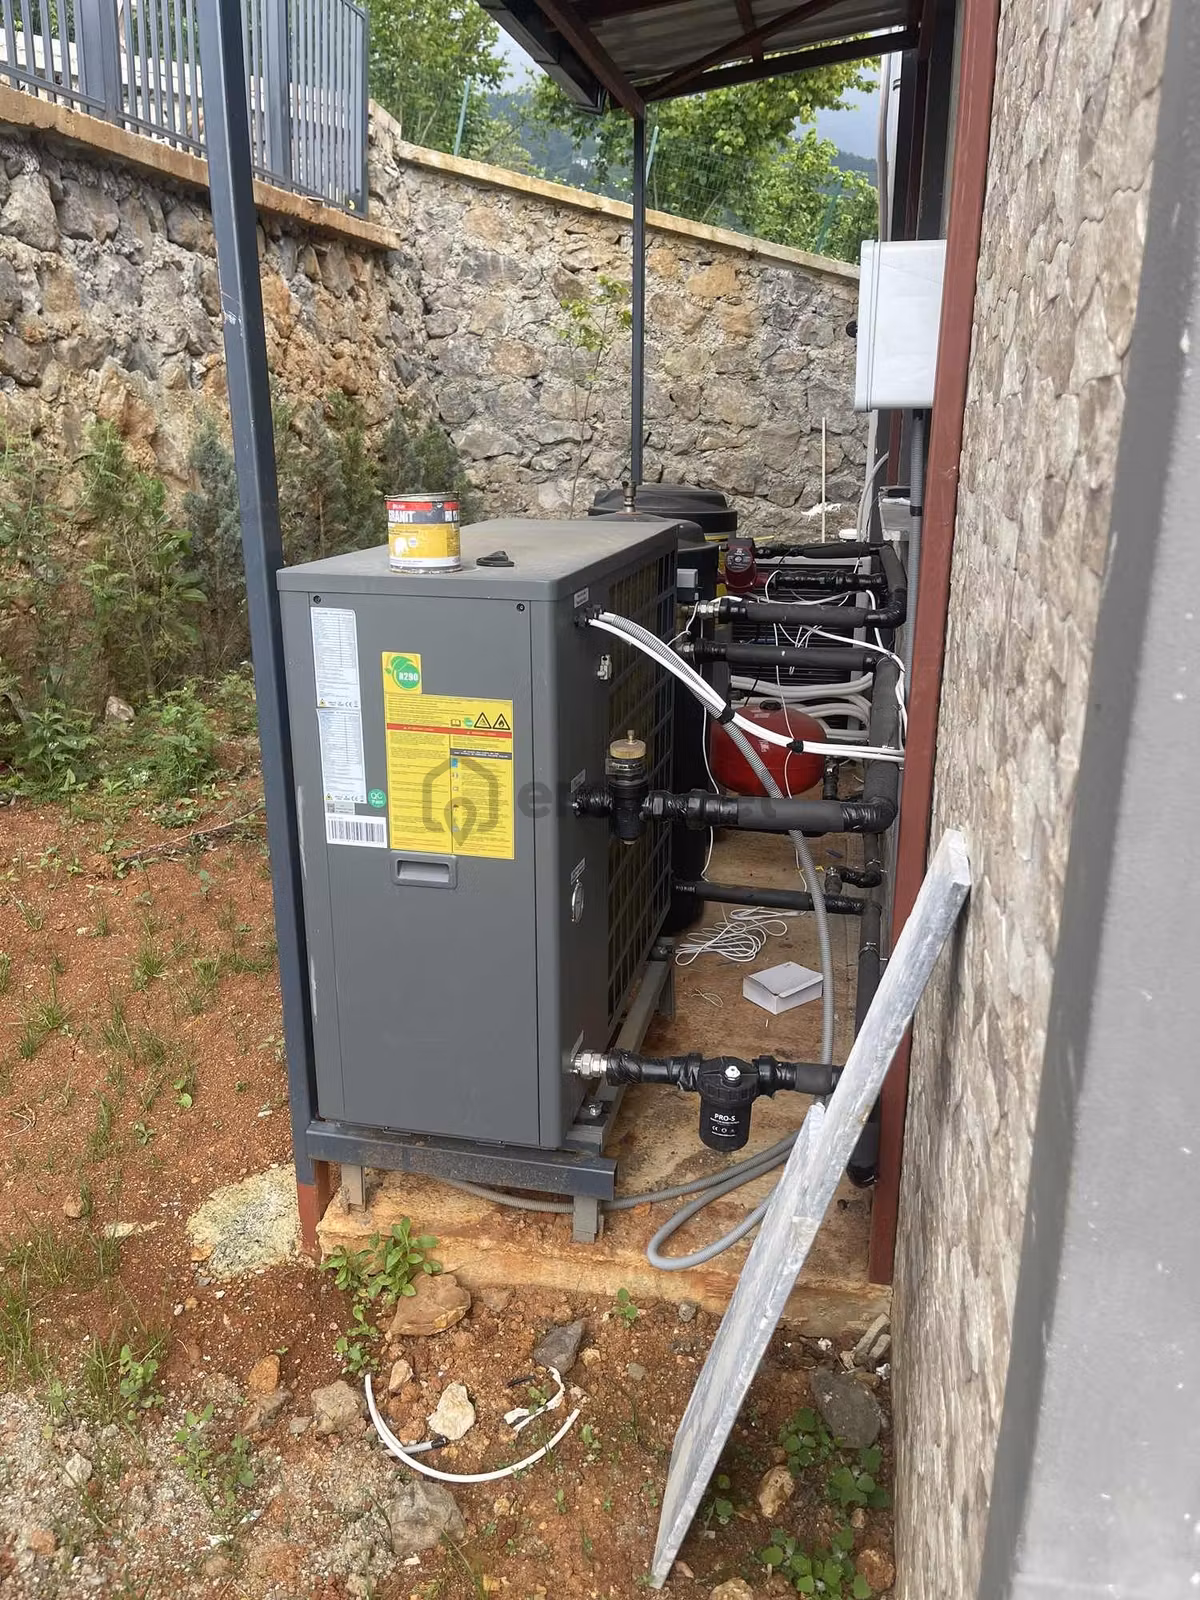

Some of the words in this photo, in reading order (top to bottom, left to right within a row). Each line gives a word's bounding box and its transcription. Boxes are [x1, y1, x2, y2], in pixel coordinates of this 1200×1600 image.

[398, 672, 418, 681] R290
[371, 791, 383, 800] QC
[714, 1113, 736, 1122] PRO-S
